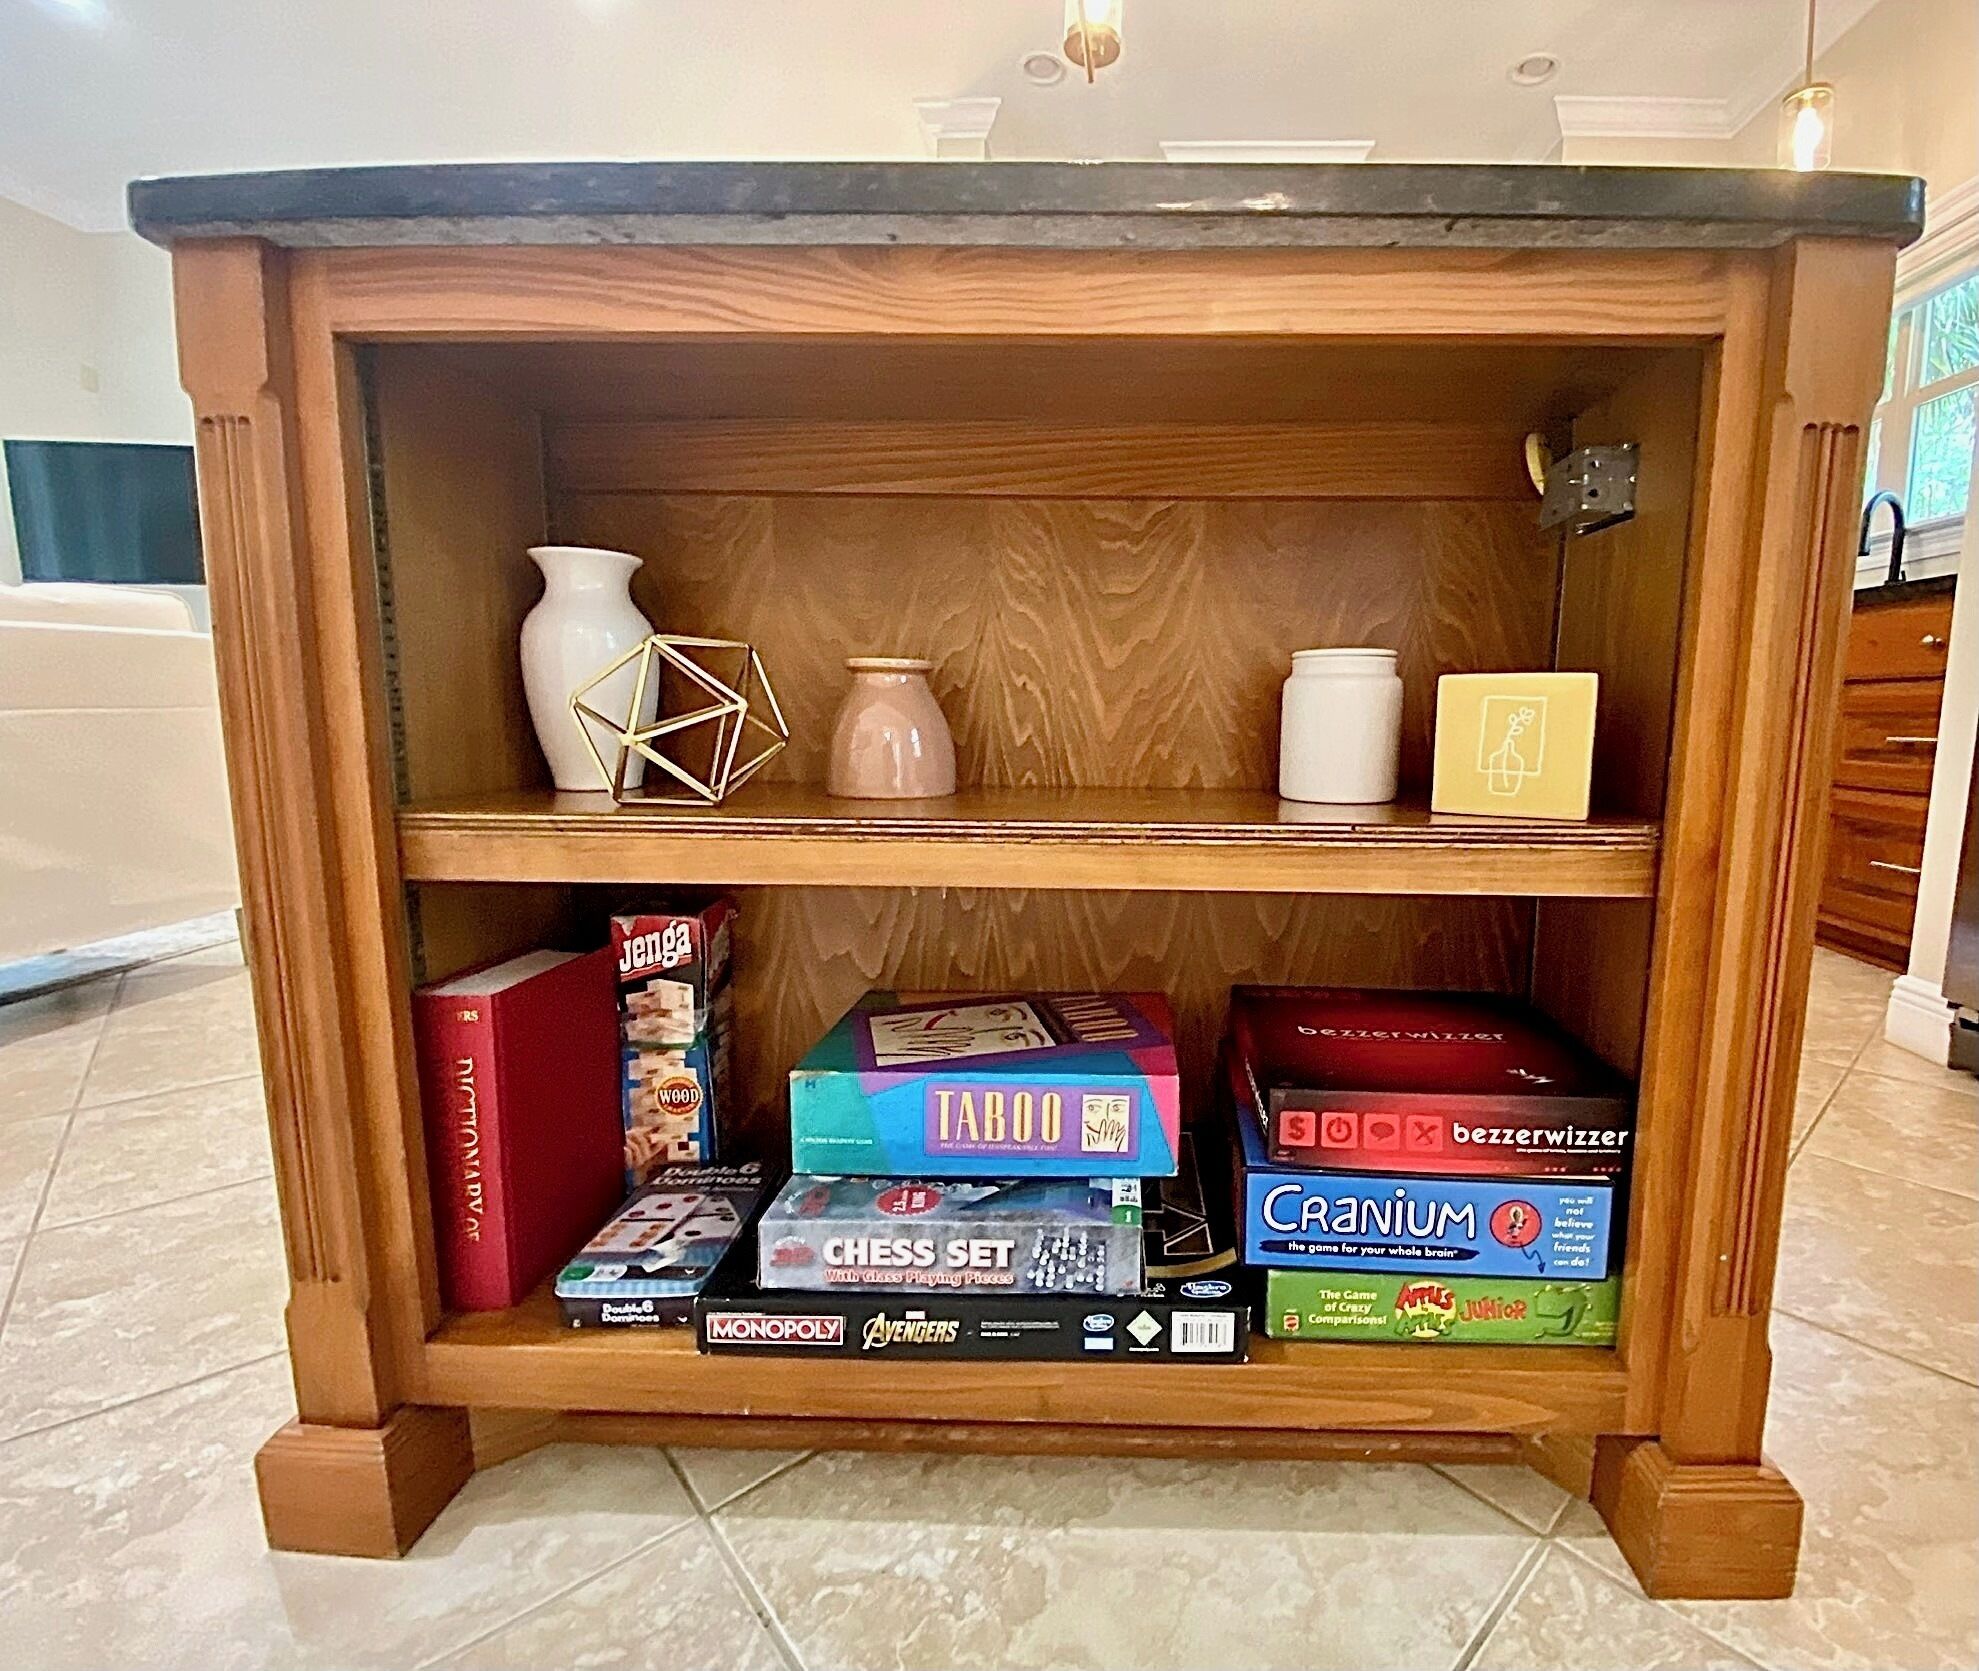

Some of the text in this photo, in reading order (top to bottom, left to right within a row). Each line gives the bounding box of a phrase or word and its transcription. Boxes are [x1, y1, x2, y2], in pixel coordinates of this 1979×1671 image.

[619, 919, 692, 972] Jenga
[1297, 1025, 1504, 1041] bezzerwizzer
[659, 1088, 700, 1105] WOOD
[935, 1090, 1062, 1143] TABOO
[1453, 1122, 1629, 1146] bezzerwizzer
[1559, 1196, 1595, 1206] you will
[1565, 1207, 1585, 1216] not
[1554, 1217, 1594, 1229] believe
[1551, 1231, 1574, 1240] what
[822, 1236, 936, 1267] CHESS
[946, 1238, 1016, 1268] SET
[1288, 1241, 1306, 1251] the
[1308, 1243, 1339, 1254] game
[1341, 1243, 1358, 1253] for
[1360, 1246, 1386, 1257] your
[1388, 1246, 1422, 1257] whole
[1553, 1241, 1592, 1253] friends
[1553, 1256, 1590, 1267] can do!
[824, 1269, 1015, 1288] With Glass Playing Pieces
[1319, 1289, 1378, 1300] The Game
[602, 1300, 655, 1314] Double 6
[1324, 1301, 1373, 1315] of Crazy
[601, 1313, 660, 1323] Dominoes
[1308, 1313, 1388, 1327] Comparisons!
[712, 1319, 839, 1340] MONOPOLY
[862, 1312, 960, 1350] AVENGERS
